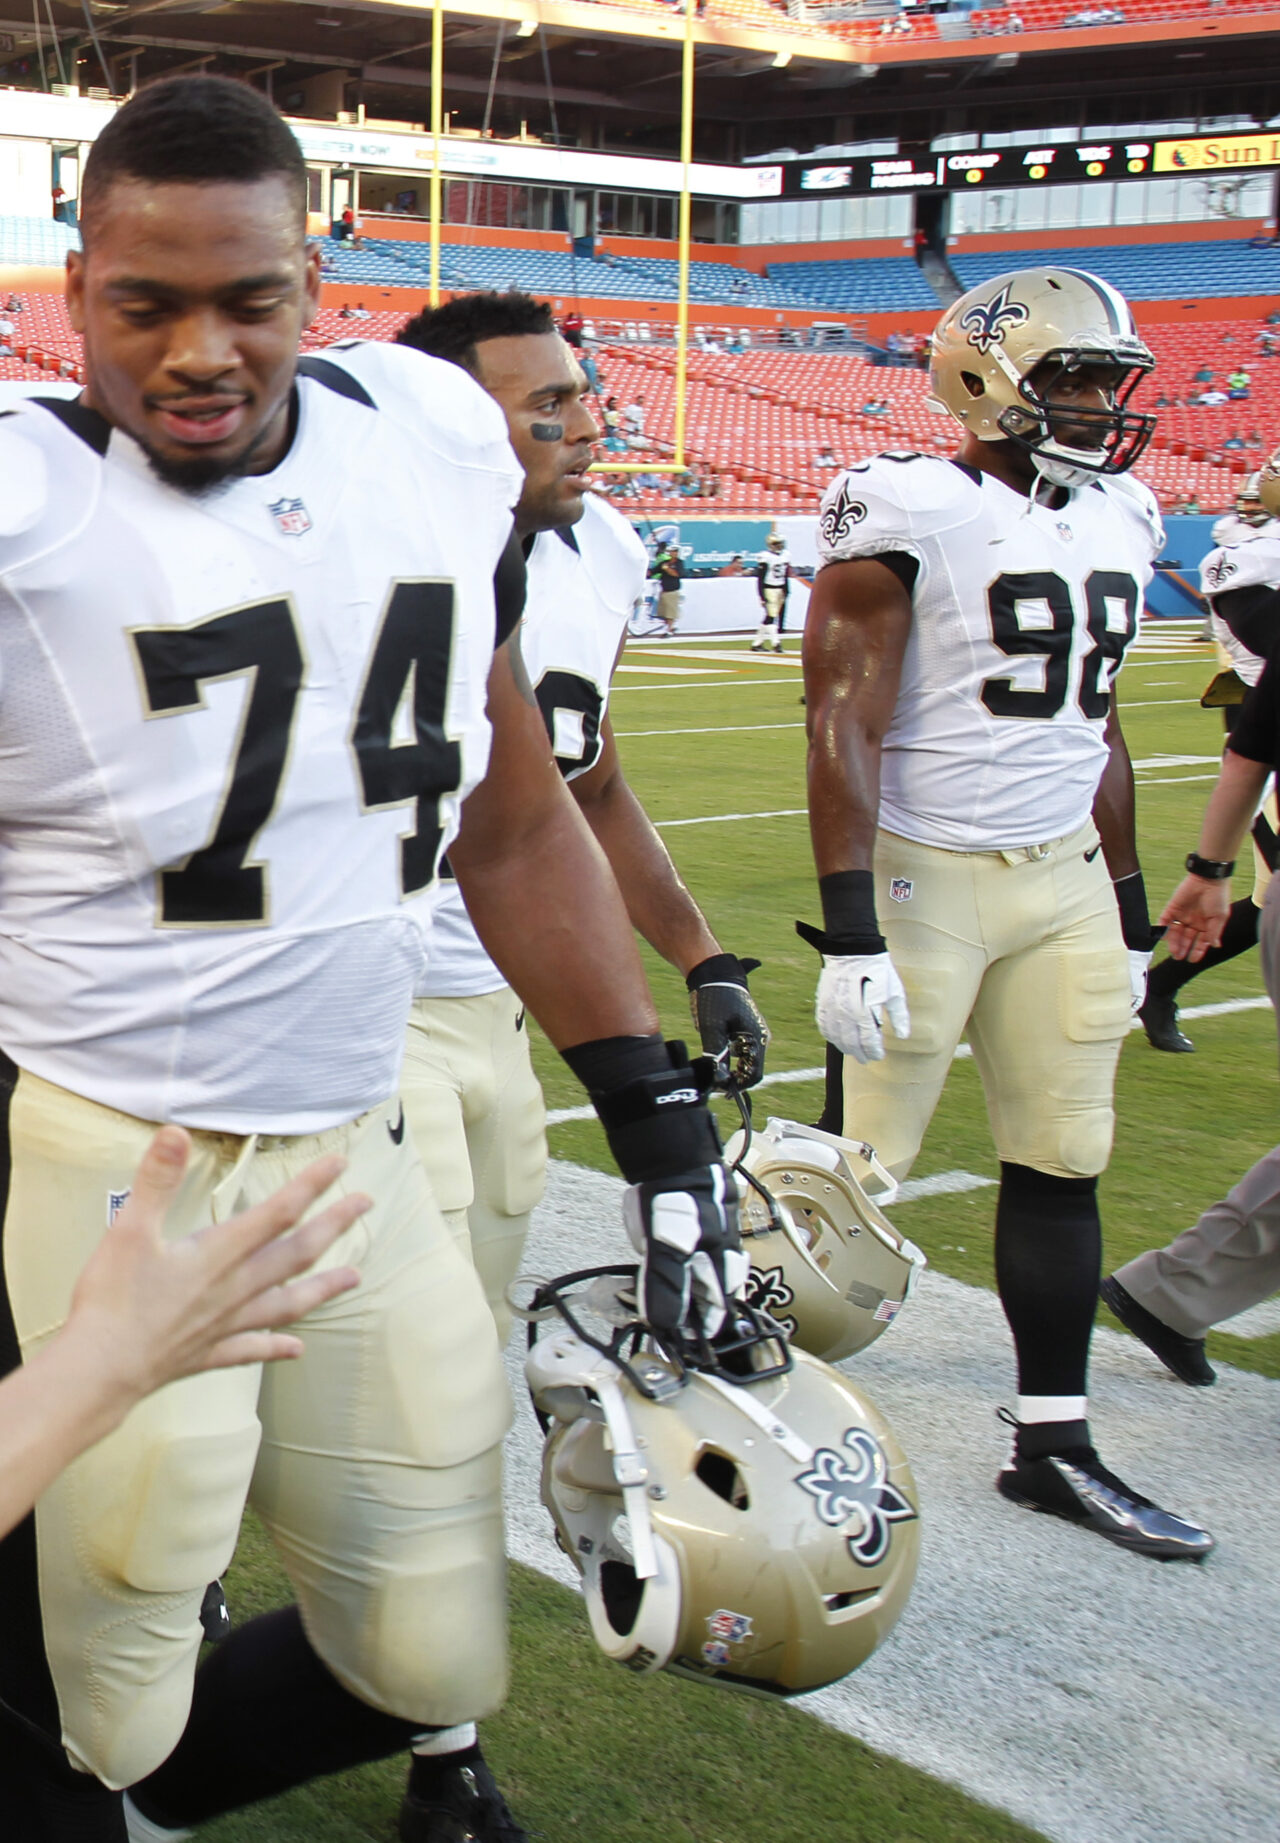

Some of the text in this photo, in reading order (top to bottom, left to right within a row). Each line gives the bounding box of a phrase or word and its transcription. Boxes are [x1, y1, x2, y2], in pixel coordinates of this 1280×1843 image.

[1203, 143, 1261, 165] Sun
[977, 567, 1139, 722] 98
[125, 575, 465, 931] 74
